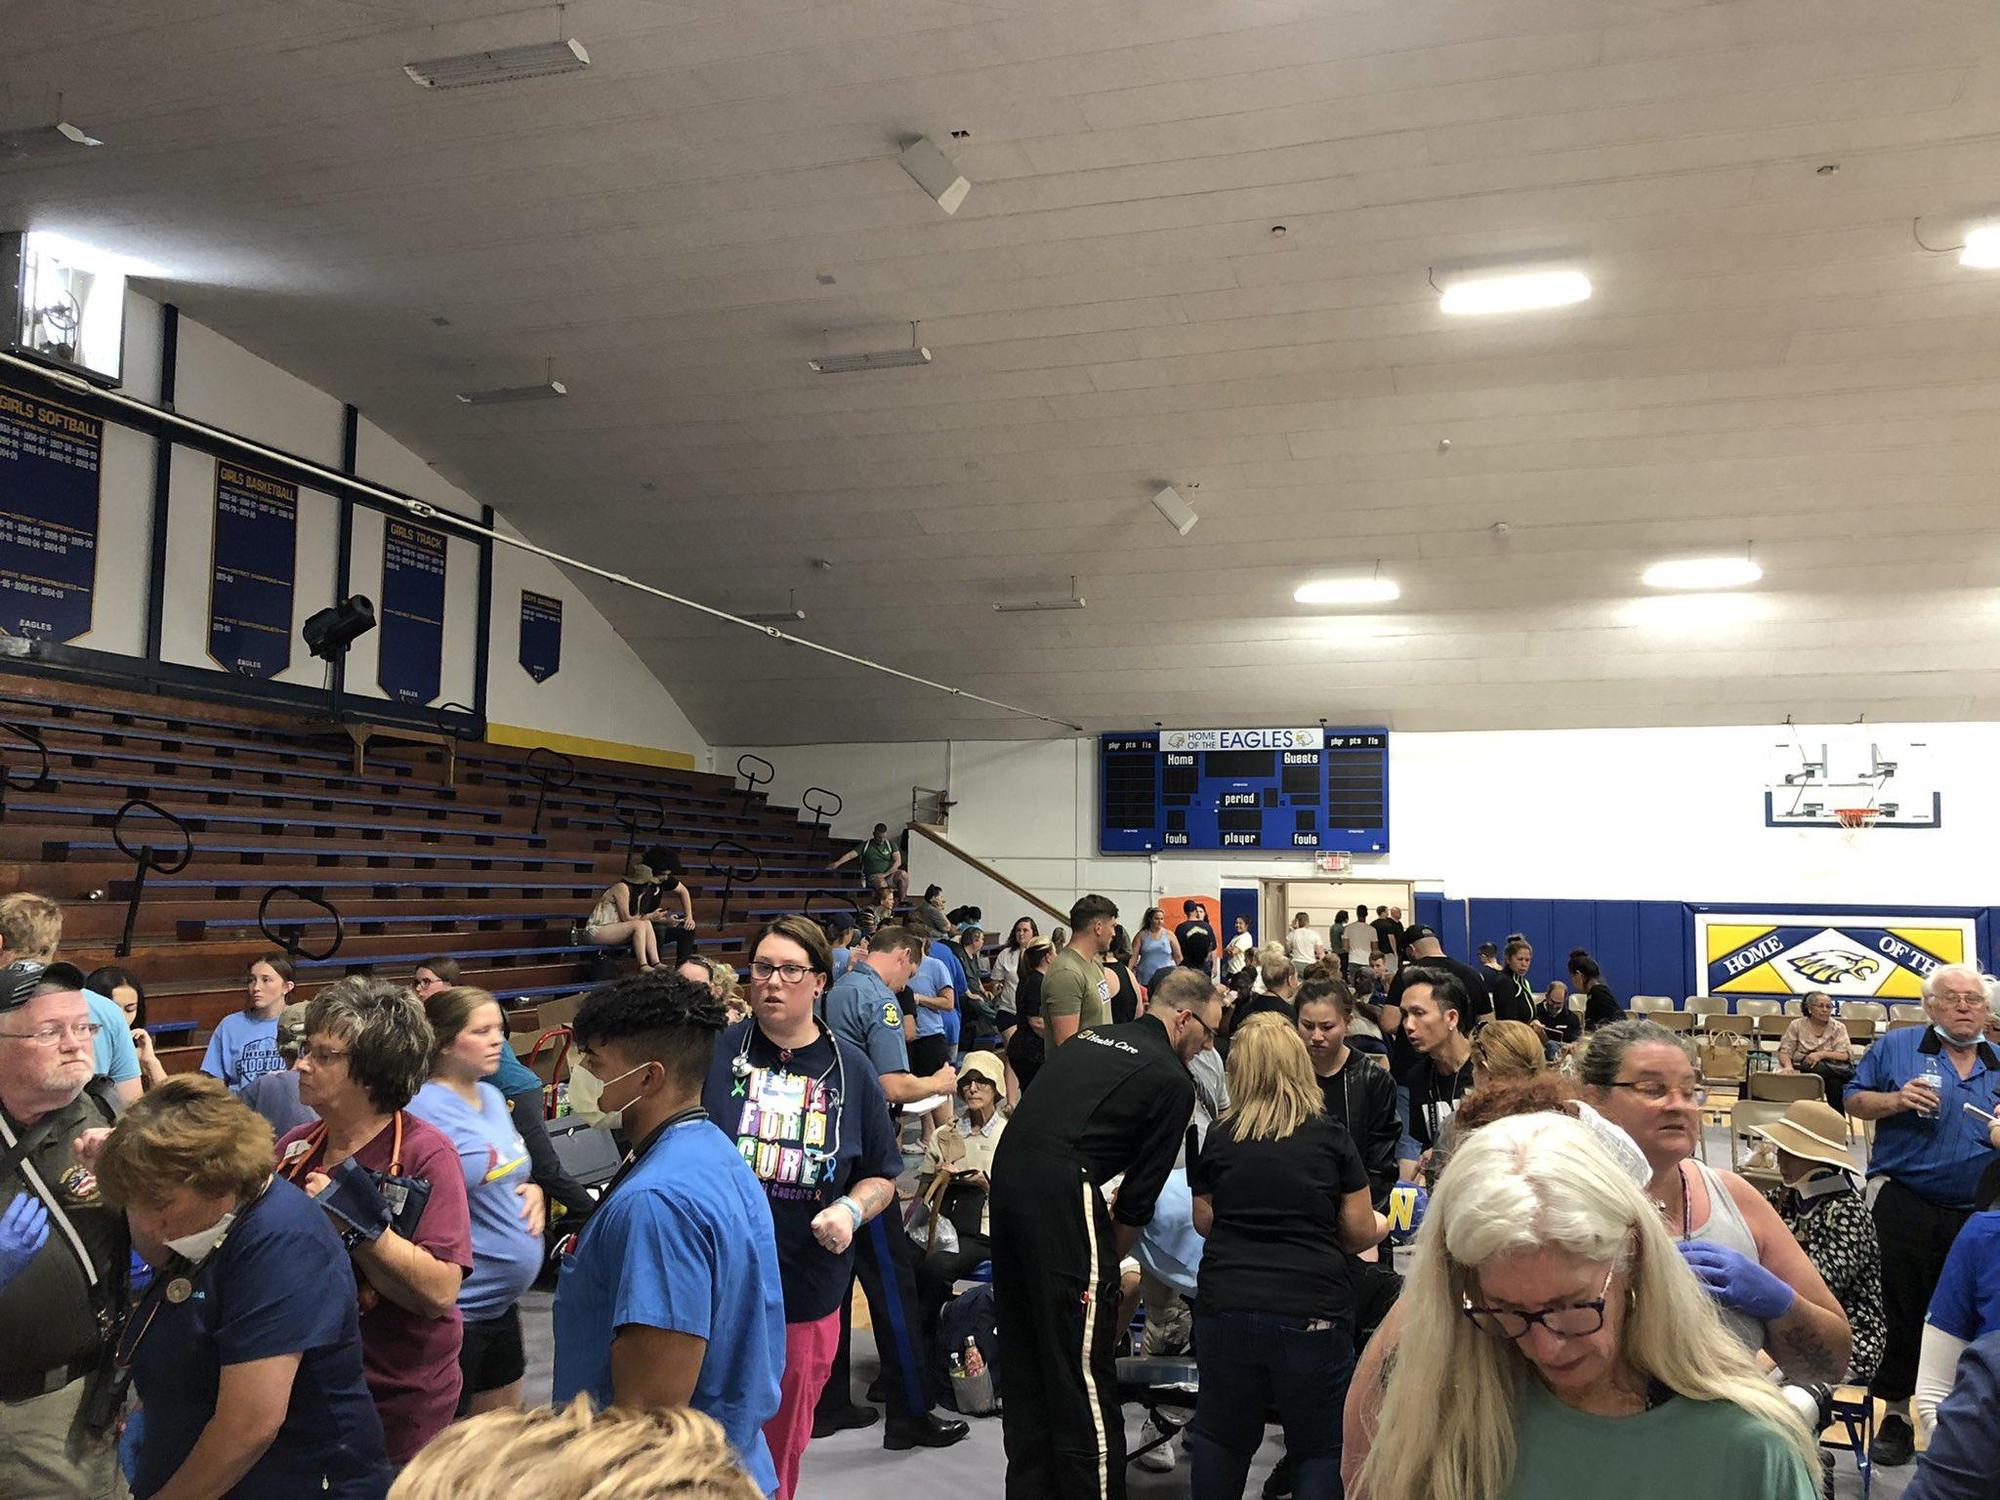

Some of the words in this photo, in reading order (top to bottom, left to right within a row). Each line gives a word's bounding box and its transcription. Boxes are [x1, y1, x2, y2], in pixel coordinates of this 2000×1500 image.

[0, 394, 34, 418] GIRLS
[37, 407, 98, 439] SOFTBALL
[220, 467, 245, 486] GIRLS
[245, 475, 295, 502] BASKETBALL
[390, 523, 414, 541] GIRLS
[415, 531, 442, 551] TRACK
[19, 618, 52, 632] EAGLES
[237, 658, 261, 669] EAGLES
[1188, 732, 1216, 741] HOME
[1220, 730, 1293, 749] EAGLES
[1187, 741, 1200, 750] OF
[1202, 741, 1216, 750] THE
[1167, 754, 1193, 765] Home
[1284, 752, 1318, 764] Guests
[1225, 792, 1255, 806] period
[1165, 833, 1188, 845] fouls
[1224, 832, 1256, 846] player
[1293, 833, 1318, 845] fouls
[1723, 935, 1784, 975] HOME
[1879, 936, 1910, 958] OF
[1908, 950, 1942, 977] TH
[1087, 1033, 1115, 1047] Health
[1115, 1041, 1139, 1054] Care
[740, 1101, 801, 1141] FOR
[738, 1139, 819, 1185] CURE
